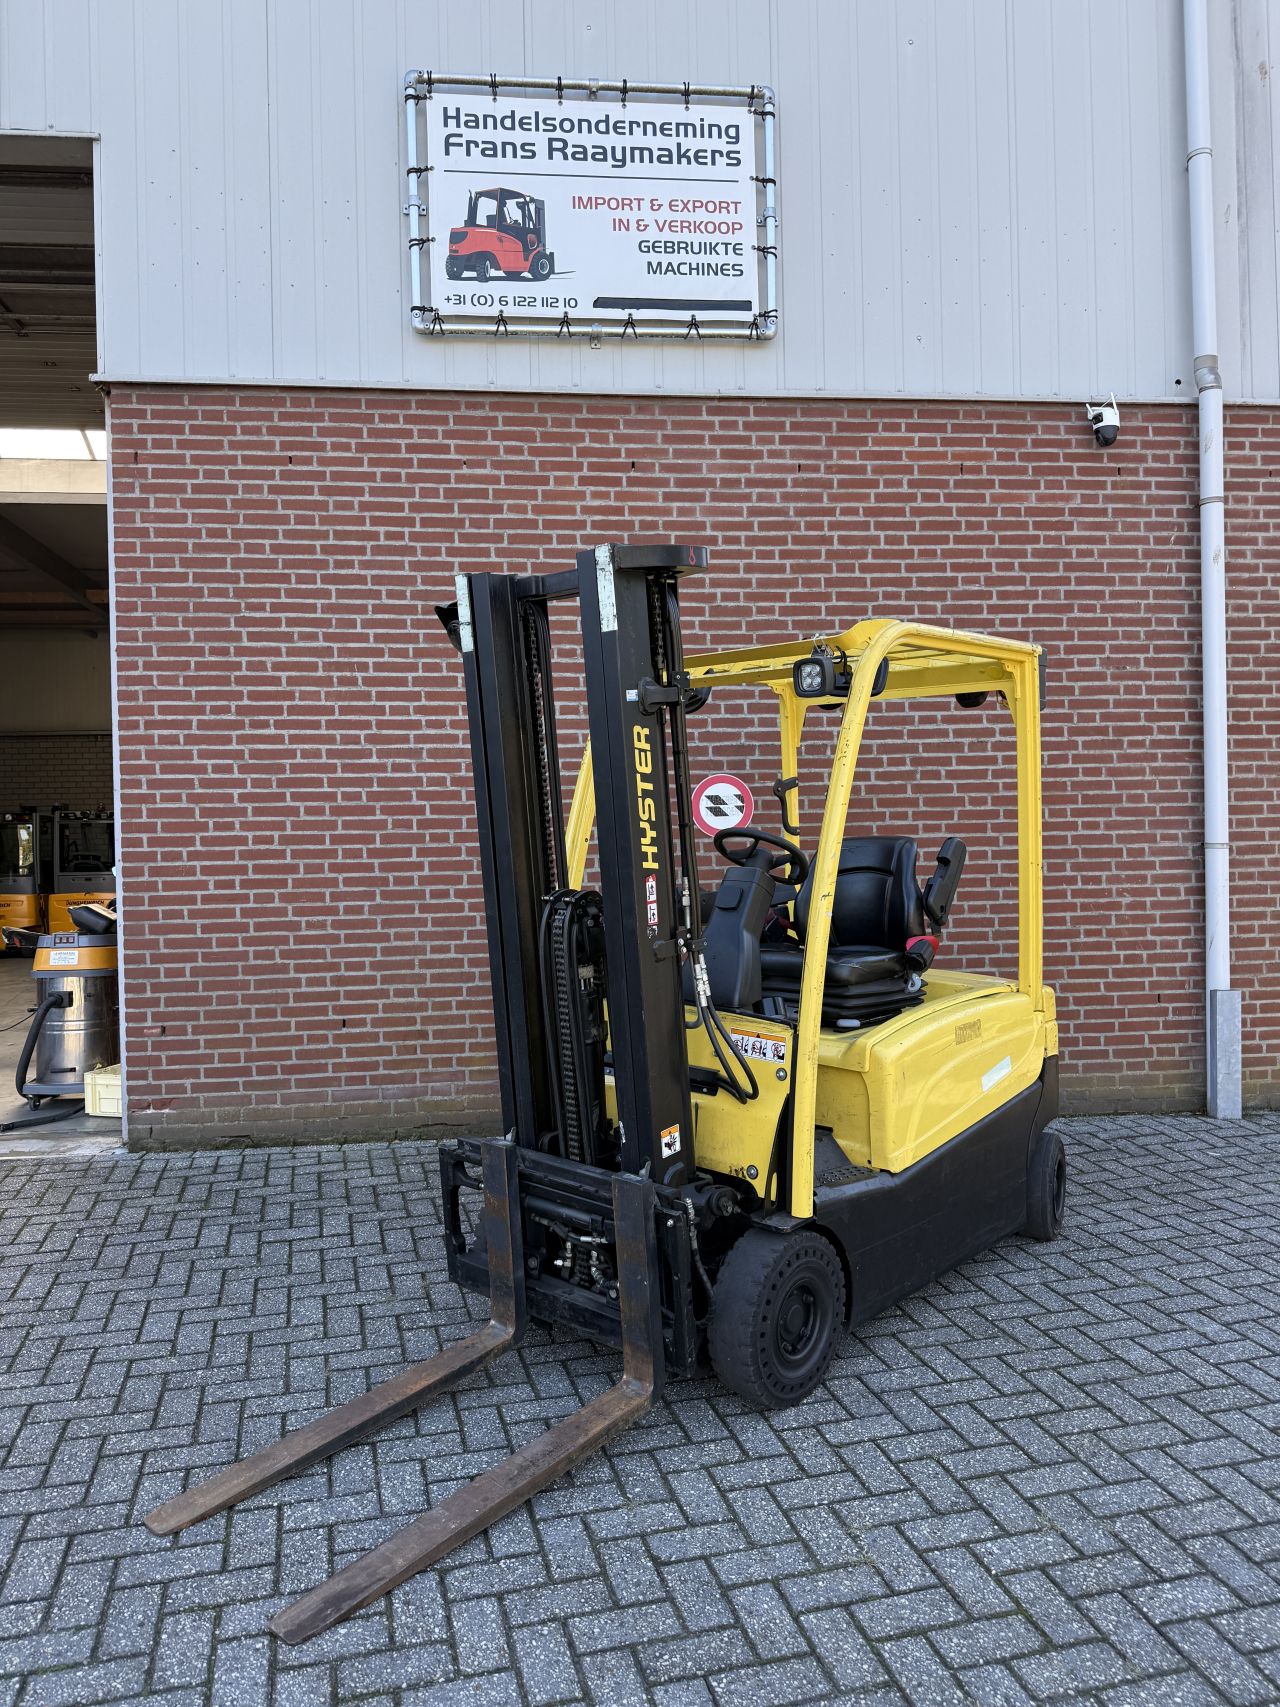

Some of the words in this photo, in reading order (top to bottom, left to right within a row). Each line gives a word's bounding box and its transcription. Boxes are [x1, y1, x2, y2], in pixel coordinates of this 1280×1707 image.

[442, 106, 741, 145] Handelsonderneming
[444, 133, 537, 160] Frans
[548, 137, 742, 169] Raaymakers
[572, 195, 645, 211] IMPORT
[650, 197, 664, 212] &
[669, 199, 742, 215] EXPORT
[612, 218, 632, 232] IN
[636, 218, 650, 233] &
[654, 219, 743, 235] VERKOOP
[638, 239, 743, 257] GEBRUIKTE
[647, 261, 743, 277] MACHINES
[444, 294, 466, 305] +31
[471, 293, 494, 307] (0)
[499, 295, 509, 306] 6
[513, 296, 537, 307] 122
[541, 297, 559, 308] 112
[564, 297, 578, 308] 10
[633, 724, 659, 870] HYSTER
